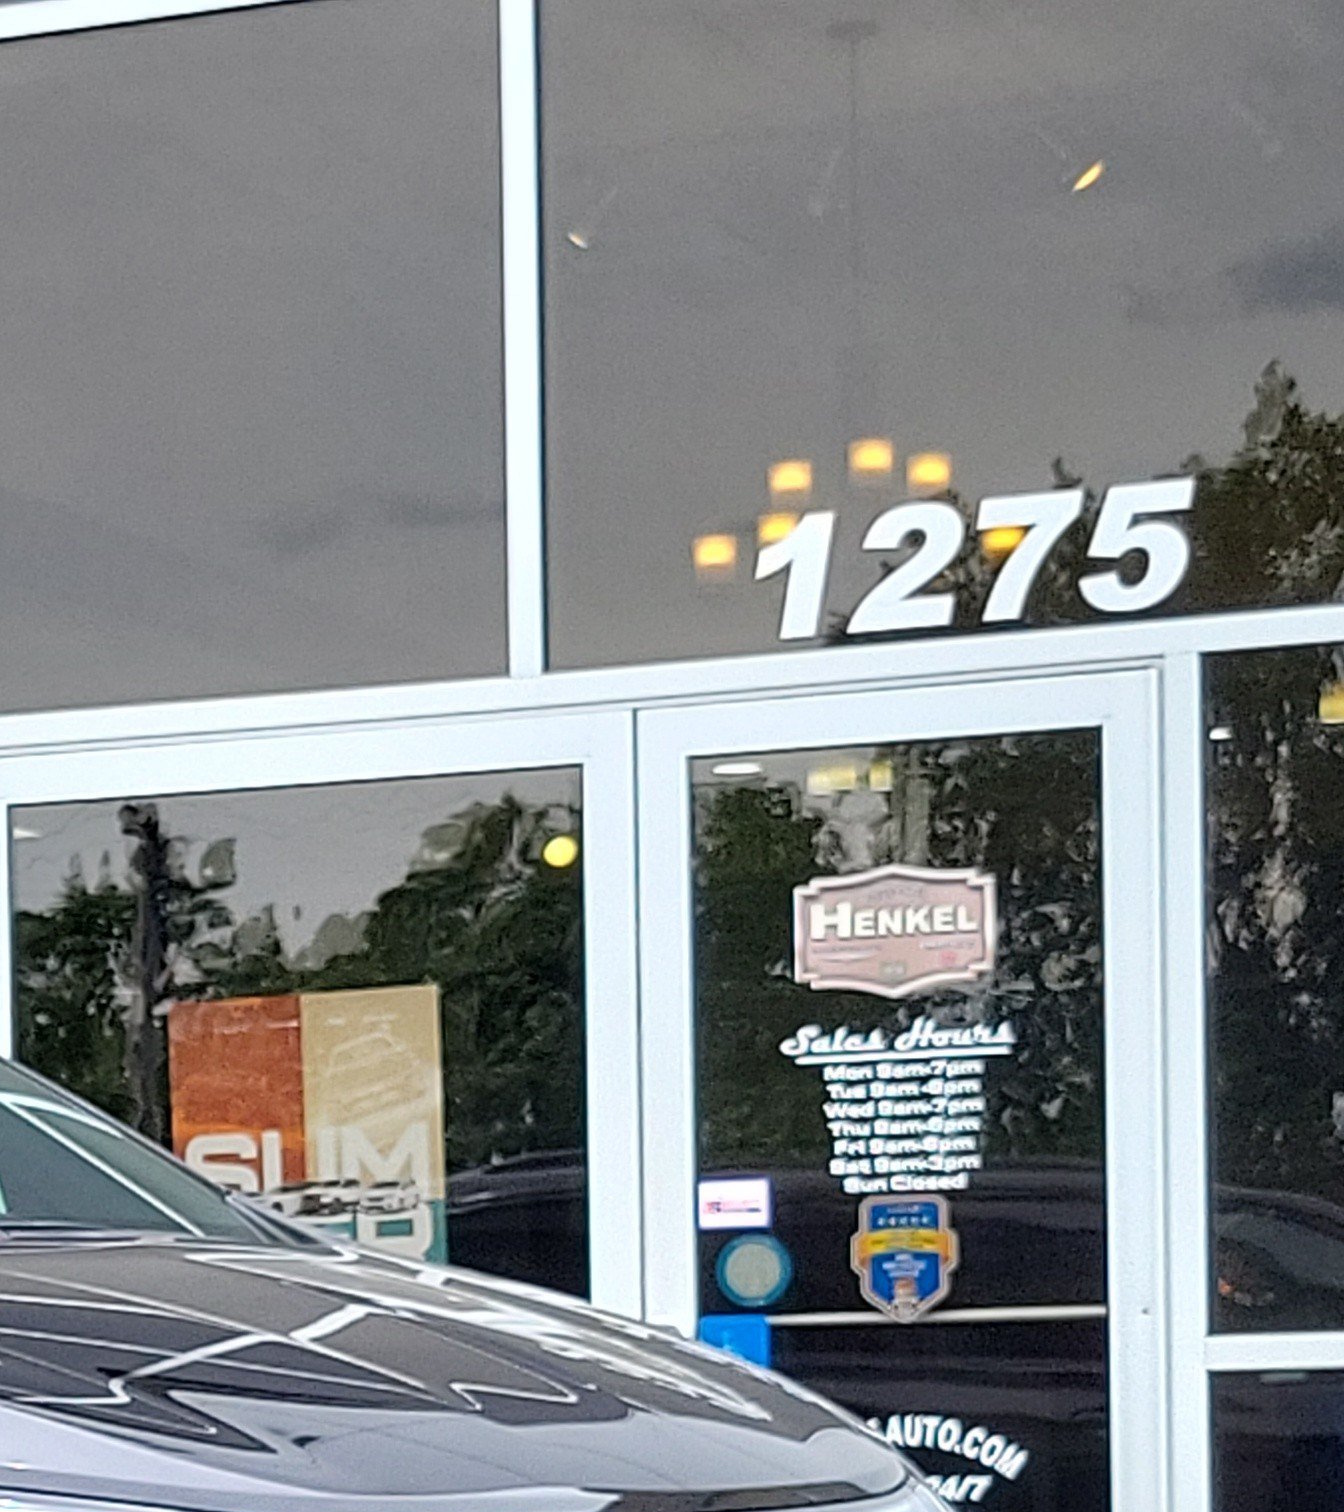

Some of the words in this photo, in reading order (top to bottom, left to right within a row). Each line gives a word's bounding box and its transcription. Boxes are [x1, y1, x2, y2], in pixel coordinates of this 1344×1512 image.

[753, 476, 1196, 640] 1275
[809, 901, 980, 942] HENKEL
[779, 1024, 886, 1056] Sales
[894, 1015, 1016, 1051] Hours
[823, 1065, 873, 1080] Mon
[823, 1101, 875, 1118] Wed
[827, 1120, 871, 1136] Thu
[834, 1139, 866, 1155] Fri
[889, 1172, 968, 1191] Closed
